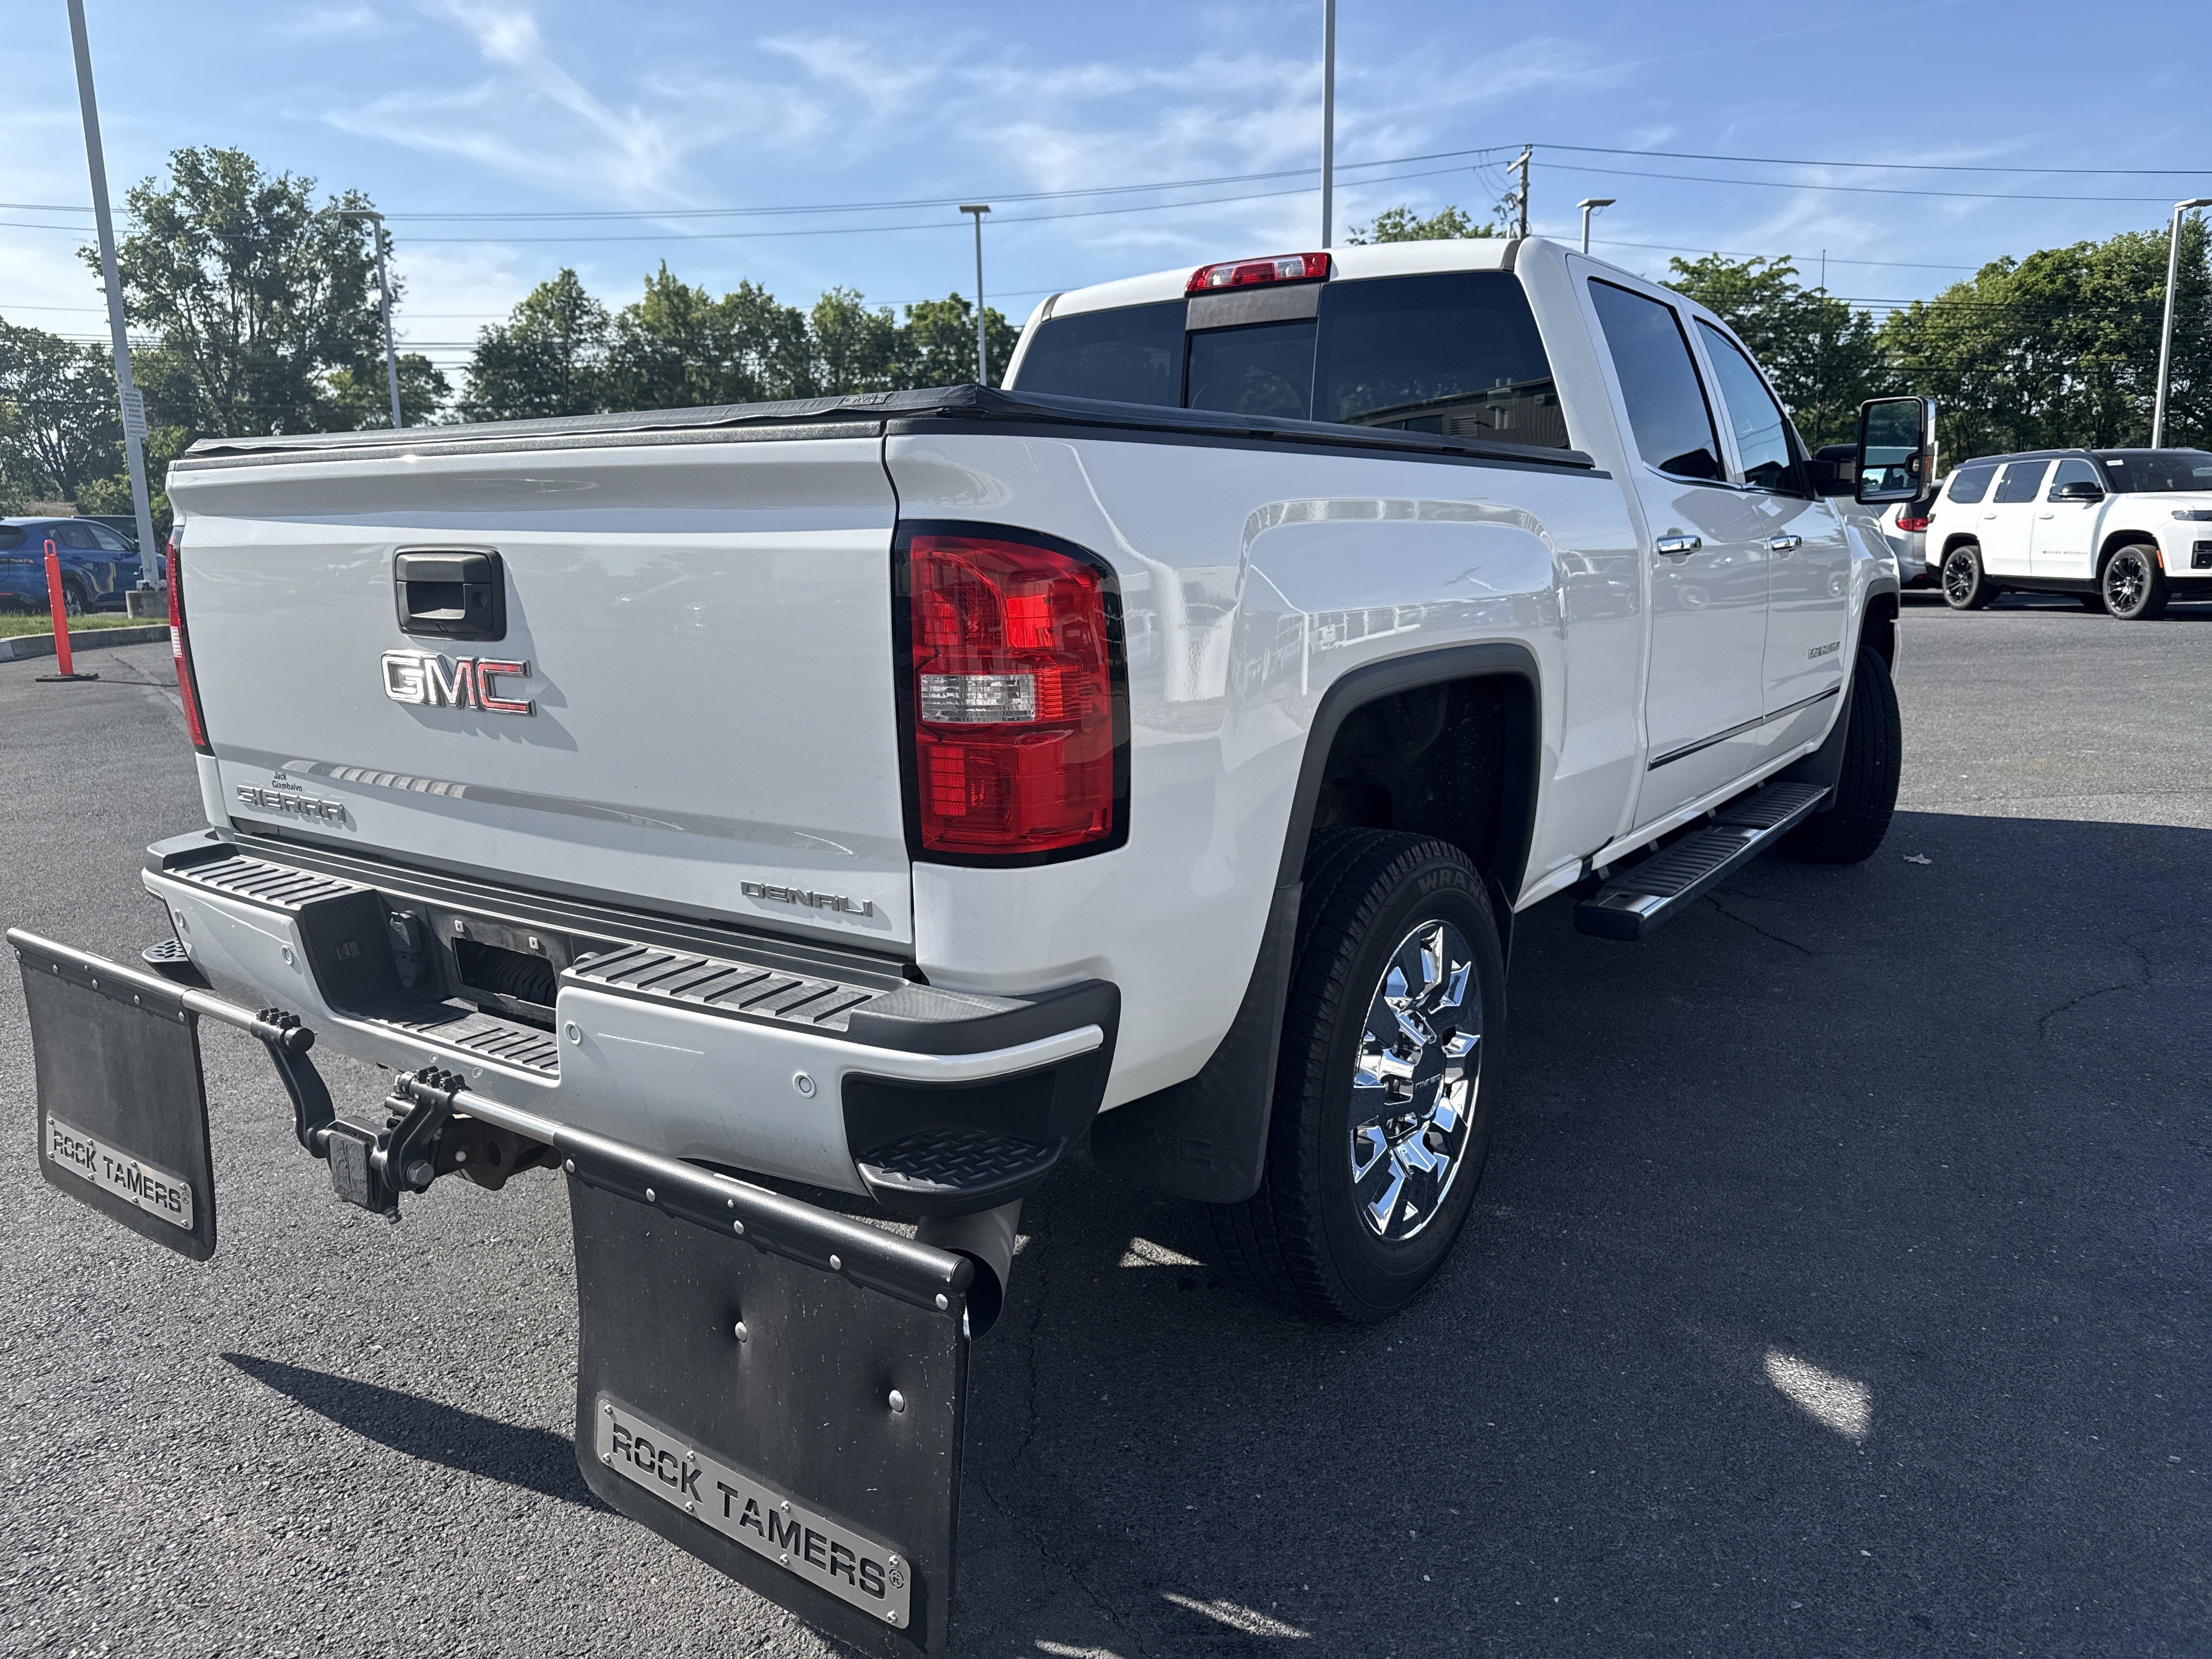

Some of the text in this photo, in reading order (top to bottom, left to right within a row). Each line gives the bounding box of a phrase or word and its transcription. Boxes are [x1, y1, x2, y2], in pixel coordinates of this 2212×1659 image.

[381, 649, 537, 716] GMC
[272, 780, 302, 792] Giambalvo
[274, 771, 287, 781] Jack
[237, 785, 347, 823] SIERRA
[740, 879, 873, 918] DENALI
[53, 1130, 98, 1174] ROCK
[612, 1422, 703, 1504] ROCK
